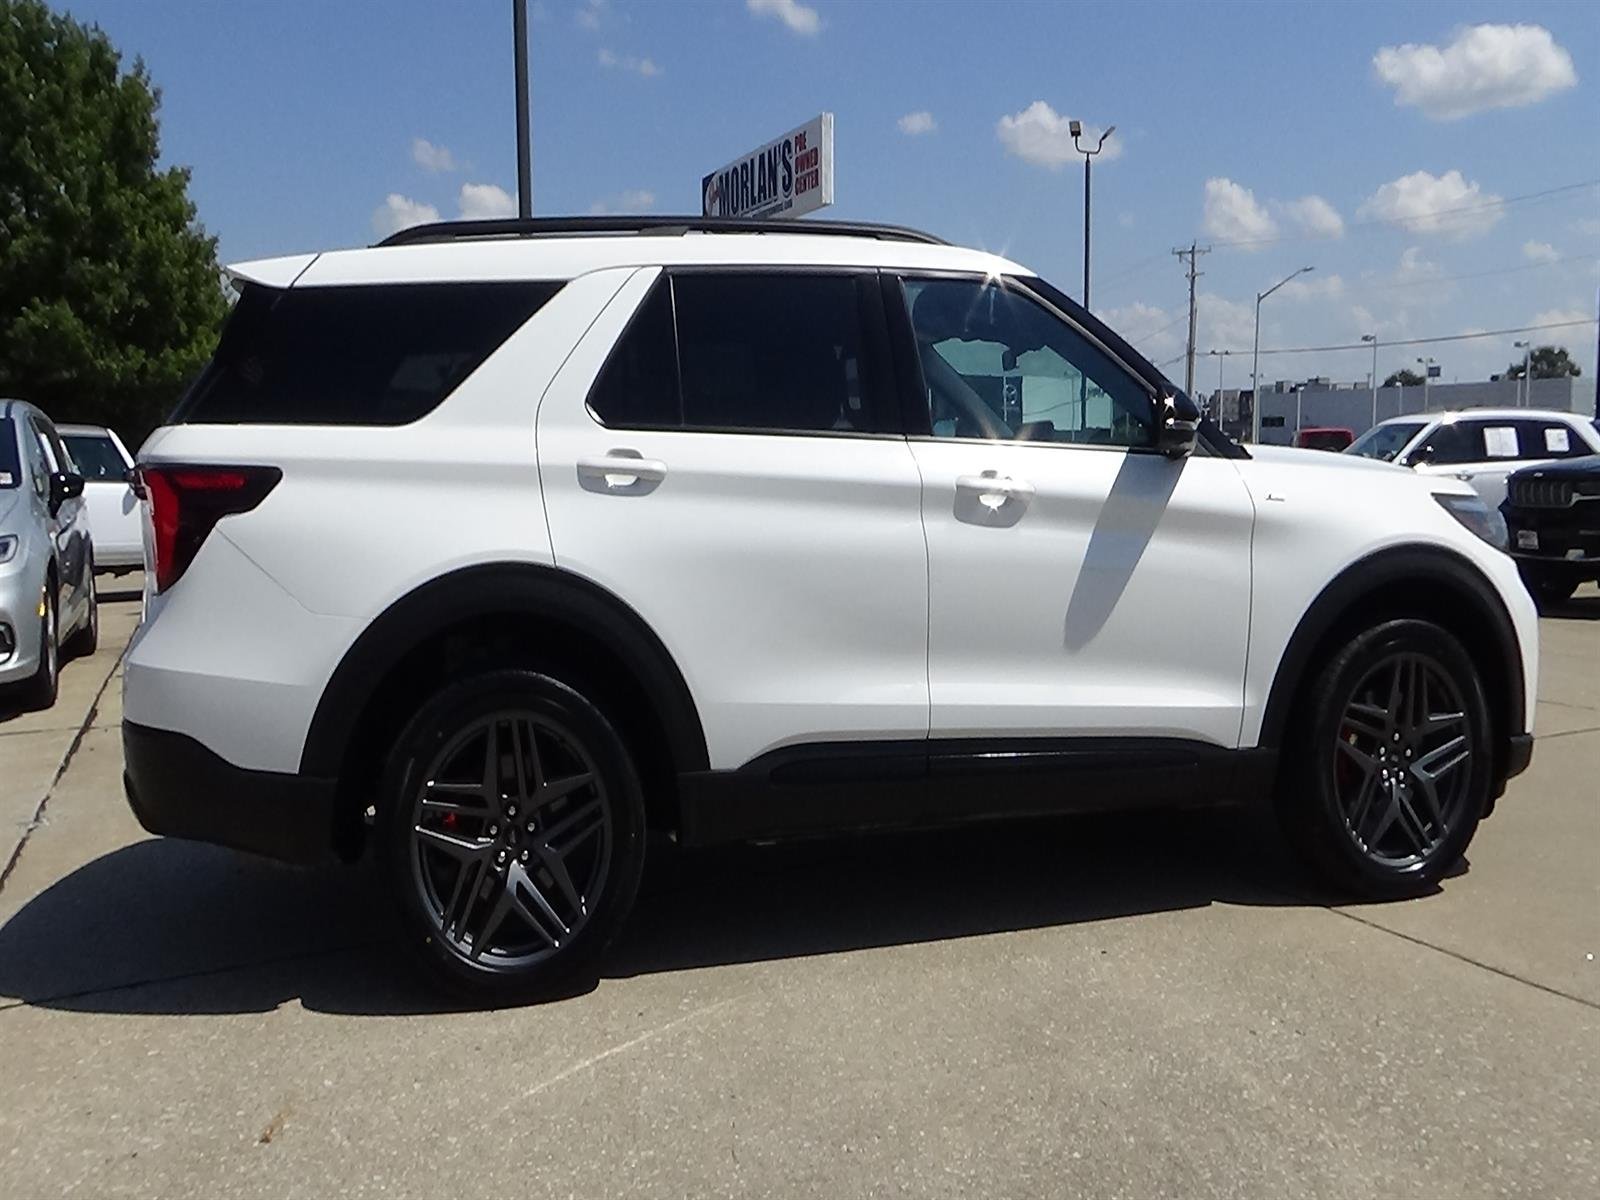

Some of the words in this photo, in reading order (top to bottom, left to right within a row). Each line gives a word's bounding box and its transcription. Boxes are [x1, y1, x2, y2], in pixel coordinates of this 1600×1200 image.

[794, 130, 807, 154] PRE
[794, 146, 819, 175] OWNED
[718, 139, 793, 216] MORLAN'S
[794, 168, 819, 196] CENTER
